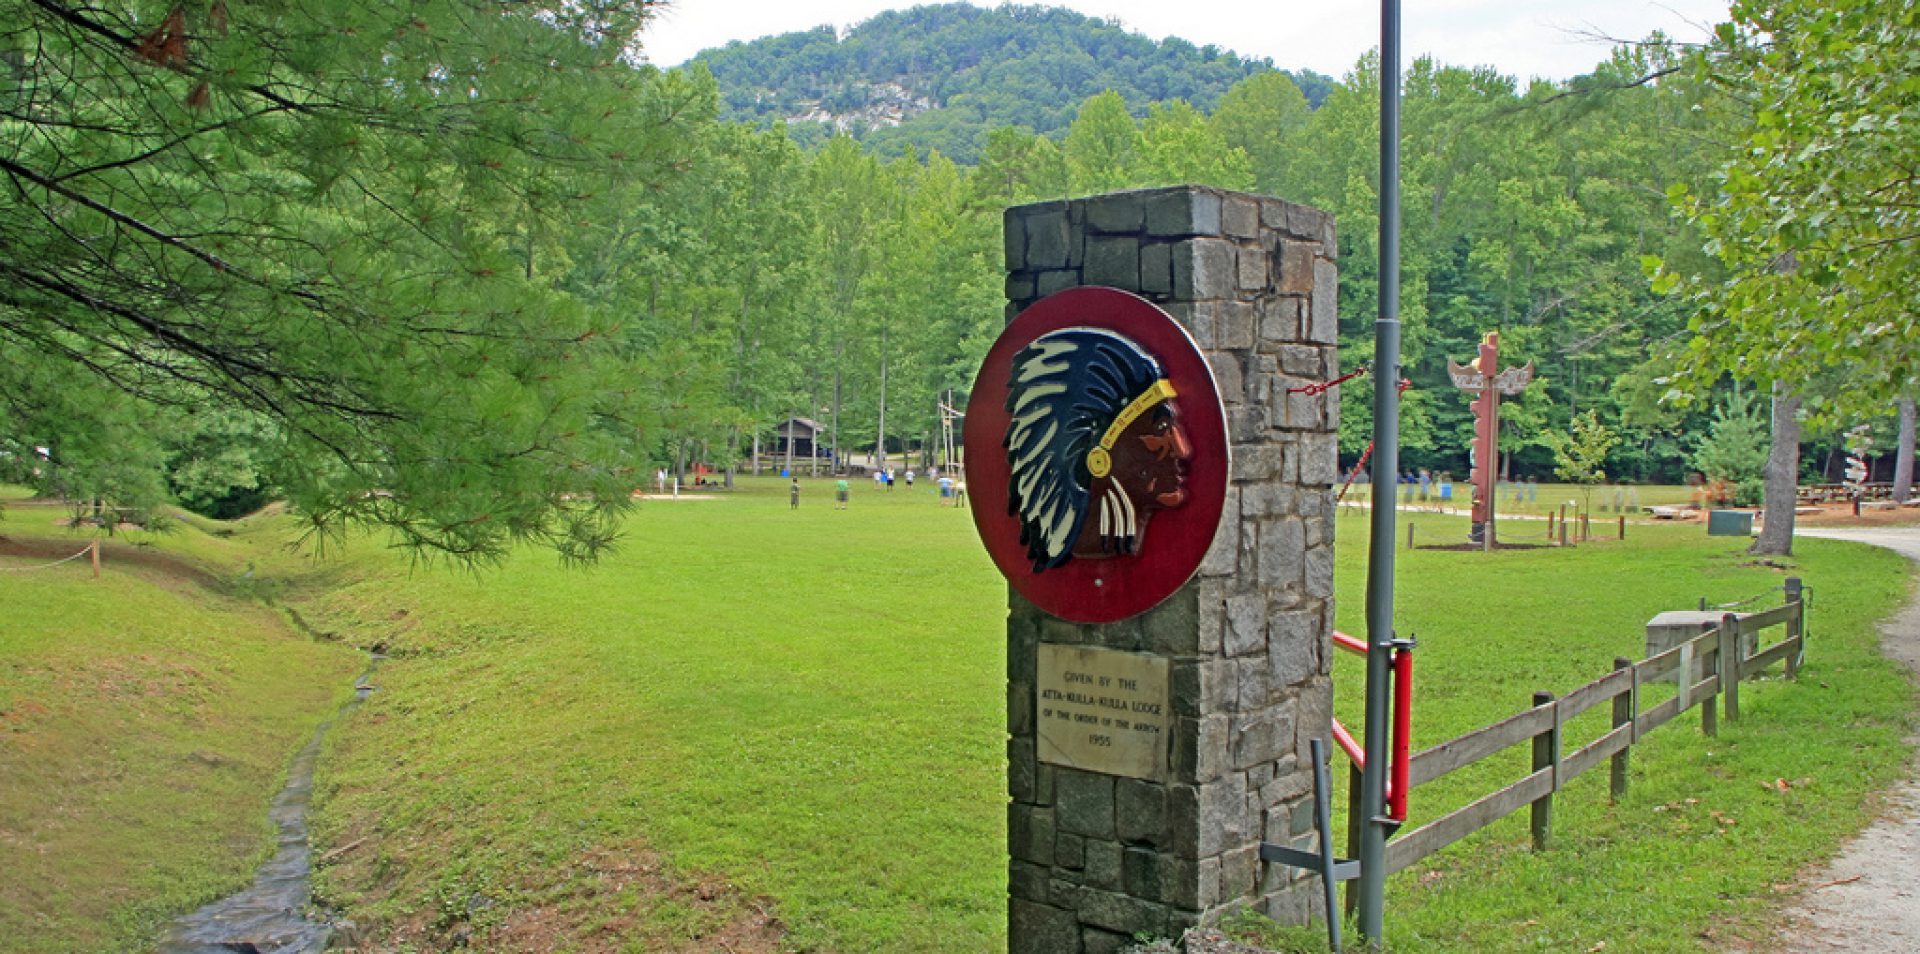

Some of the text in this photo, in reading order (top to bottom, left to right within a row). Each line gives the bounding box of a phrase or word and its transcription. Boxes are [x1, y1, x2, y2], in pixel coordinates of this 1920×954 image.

[1064, 671, 1137, 690] GIVEN BY THE
[1132, 701, 1161, 715] LODGE
[1043, 708, 1160, 734] OF THE ORDER OF THE ARROW
[1089, 734, 1111, 747] 1955
